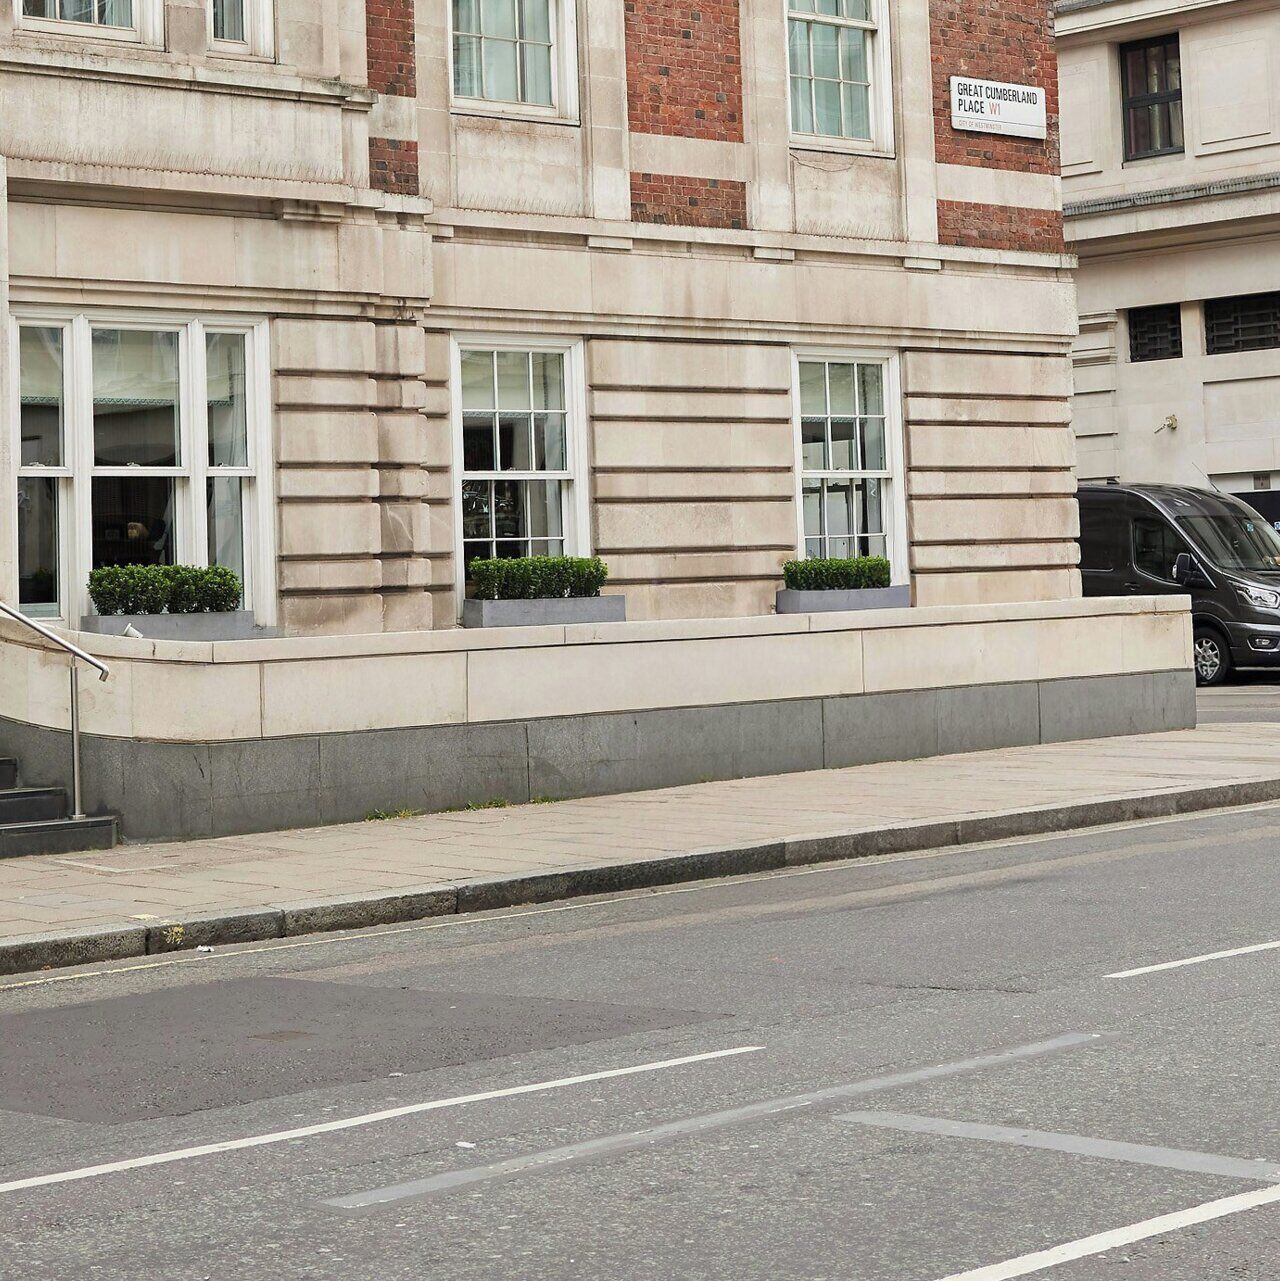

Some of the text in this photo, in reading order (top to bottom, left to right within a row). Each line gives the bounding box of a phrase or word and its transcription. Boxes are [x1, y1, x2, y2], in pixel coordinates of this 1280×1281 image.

[958, 82, 1037, 104] GREAT CUMBERLAND
[958, 99, 1000, 115] PLACE W1
